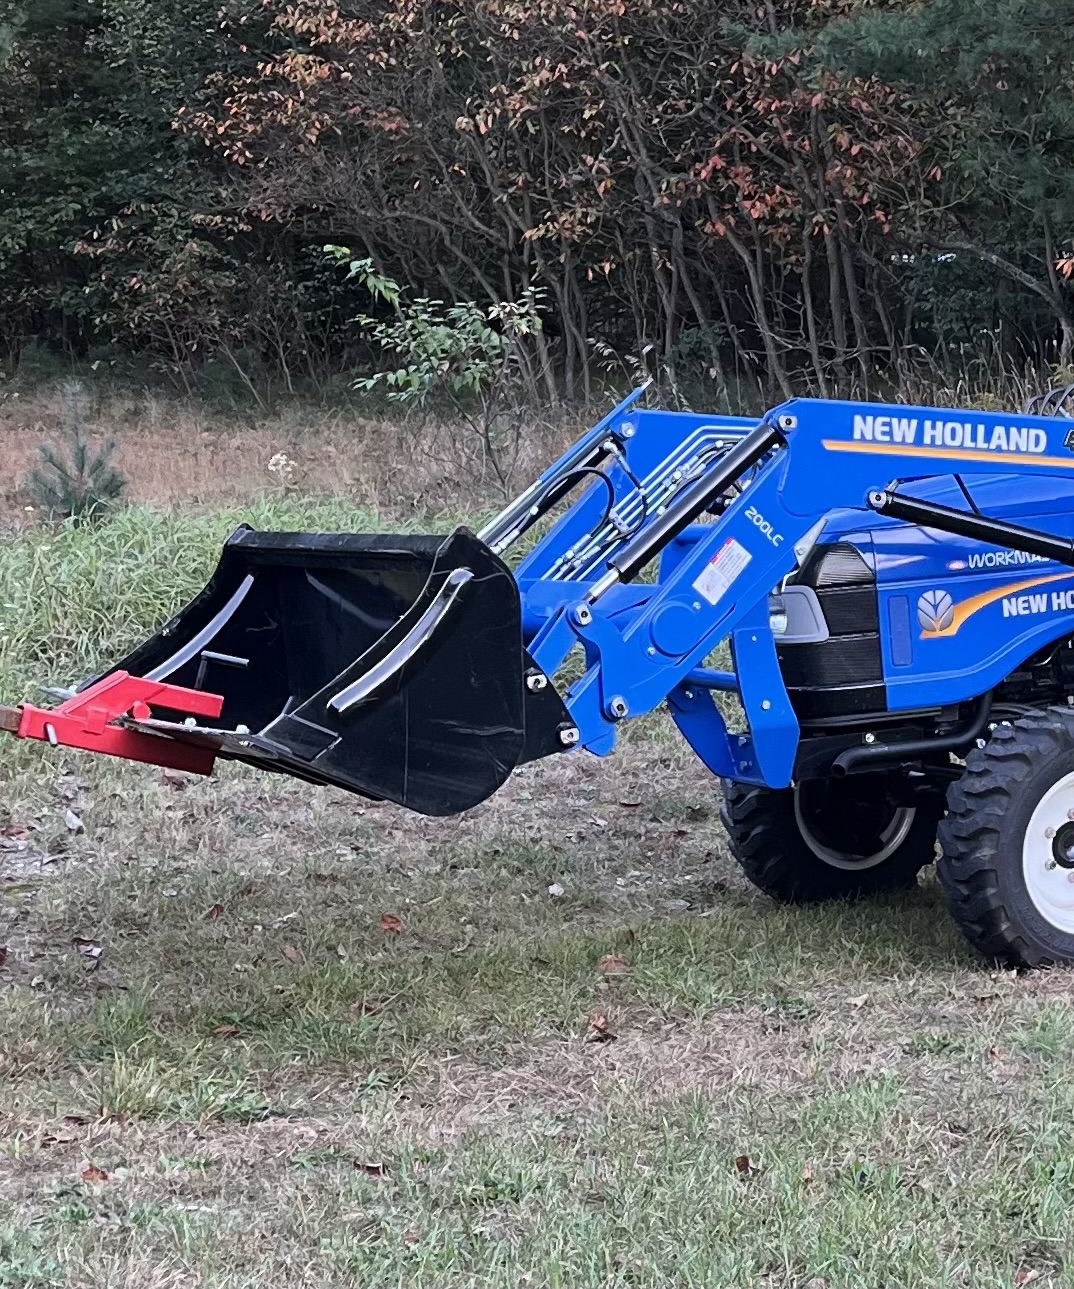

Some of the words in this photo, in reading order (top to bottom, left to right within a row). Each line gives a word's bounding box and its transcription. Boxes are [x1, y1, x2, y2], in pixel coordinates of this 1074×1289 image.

[853, 414, 918, 444] NEW
[923, 419, 1047, 453] HOLLAND
[744, 505, 784, 547] 200LC
[1002, 593, 1048, 618] NEW
